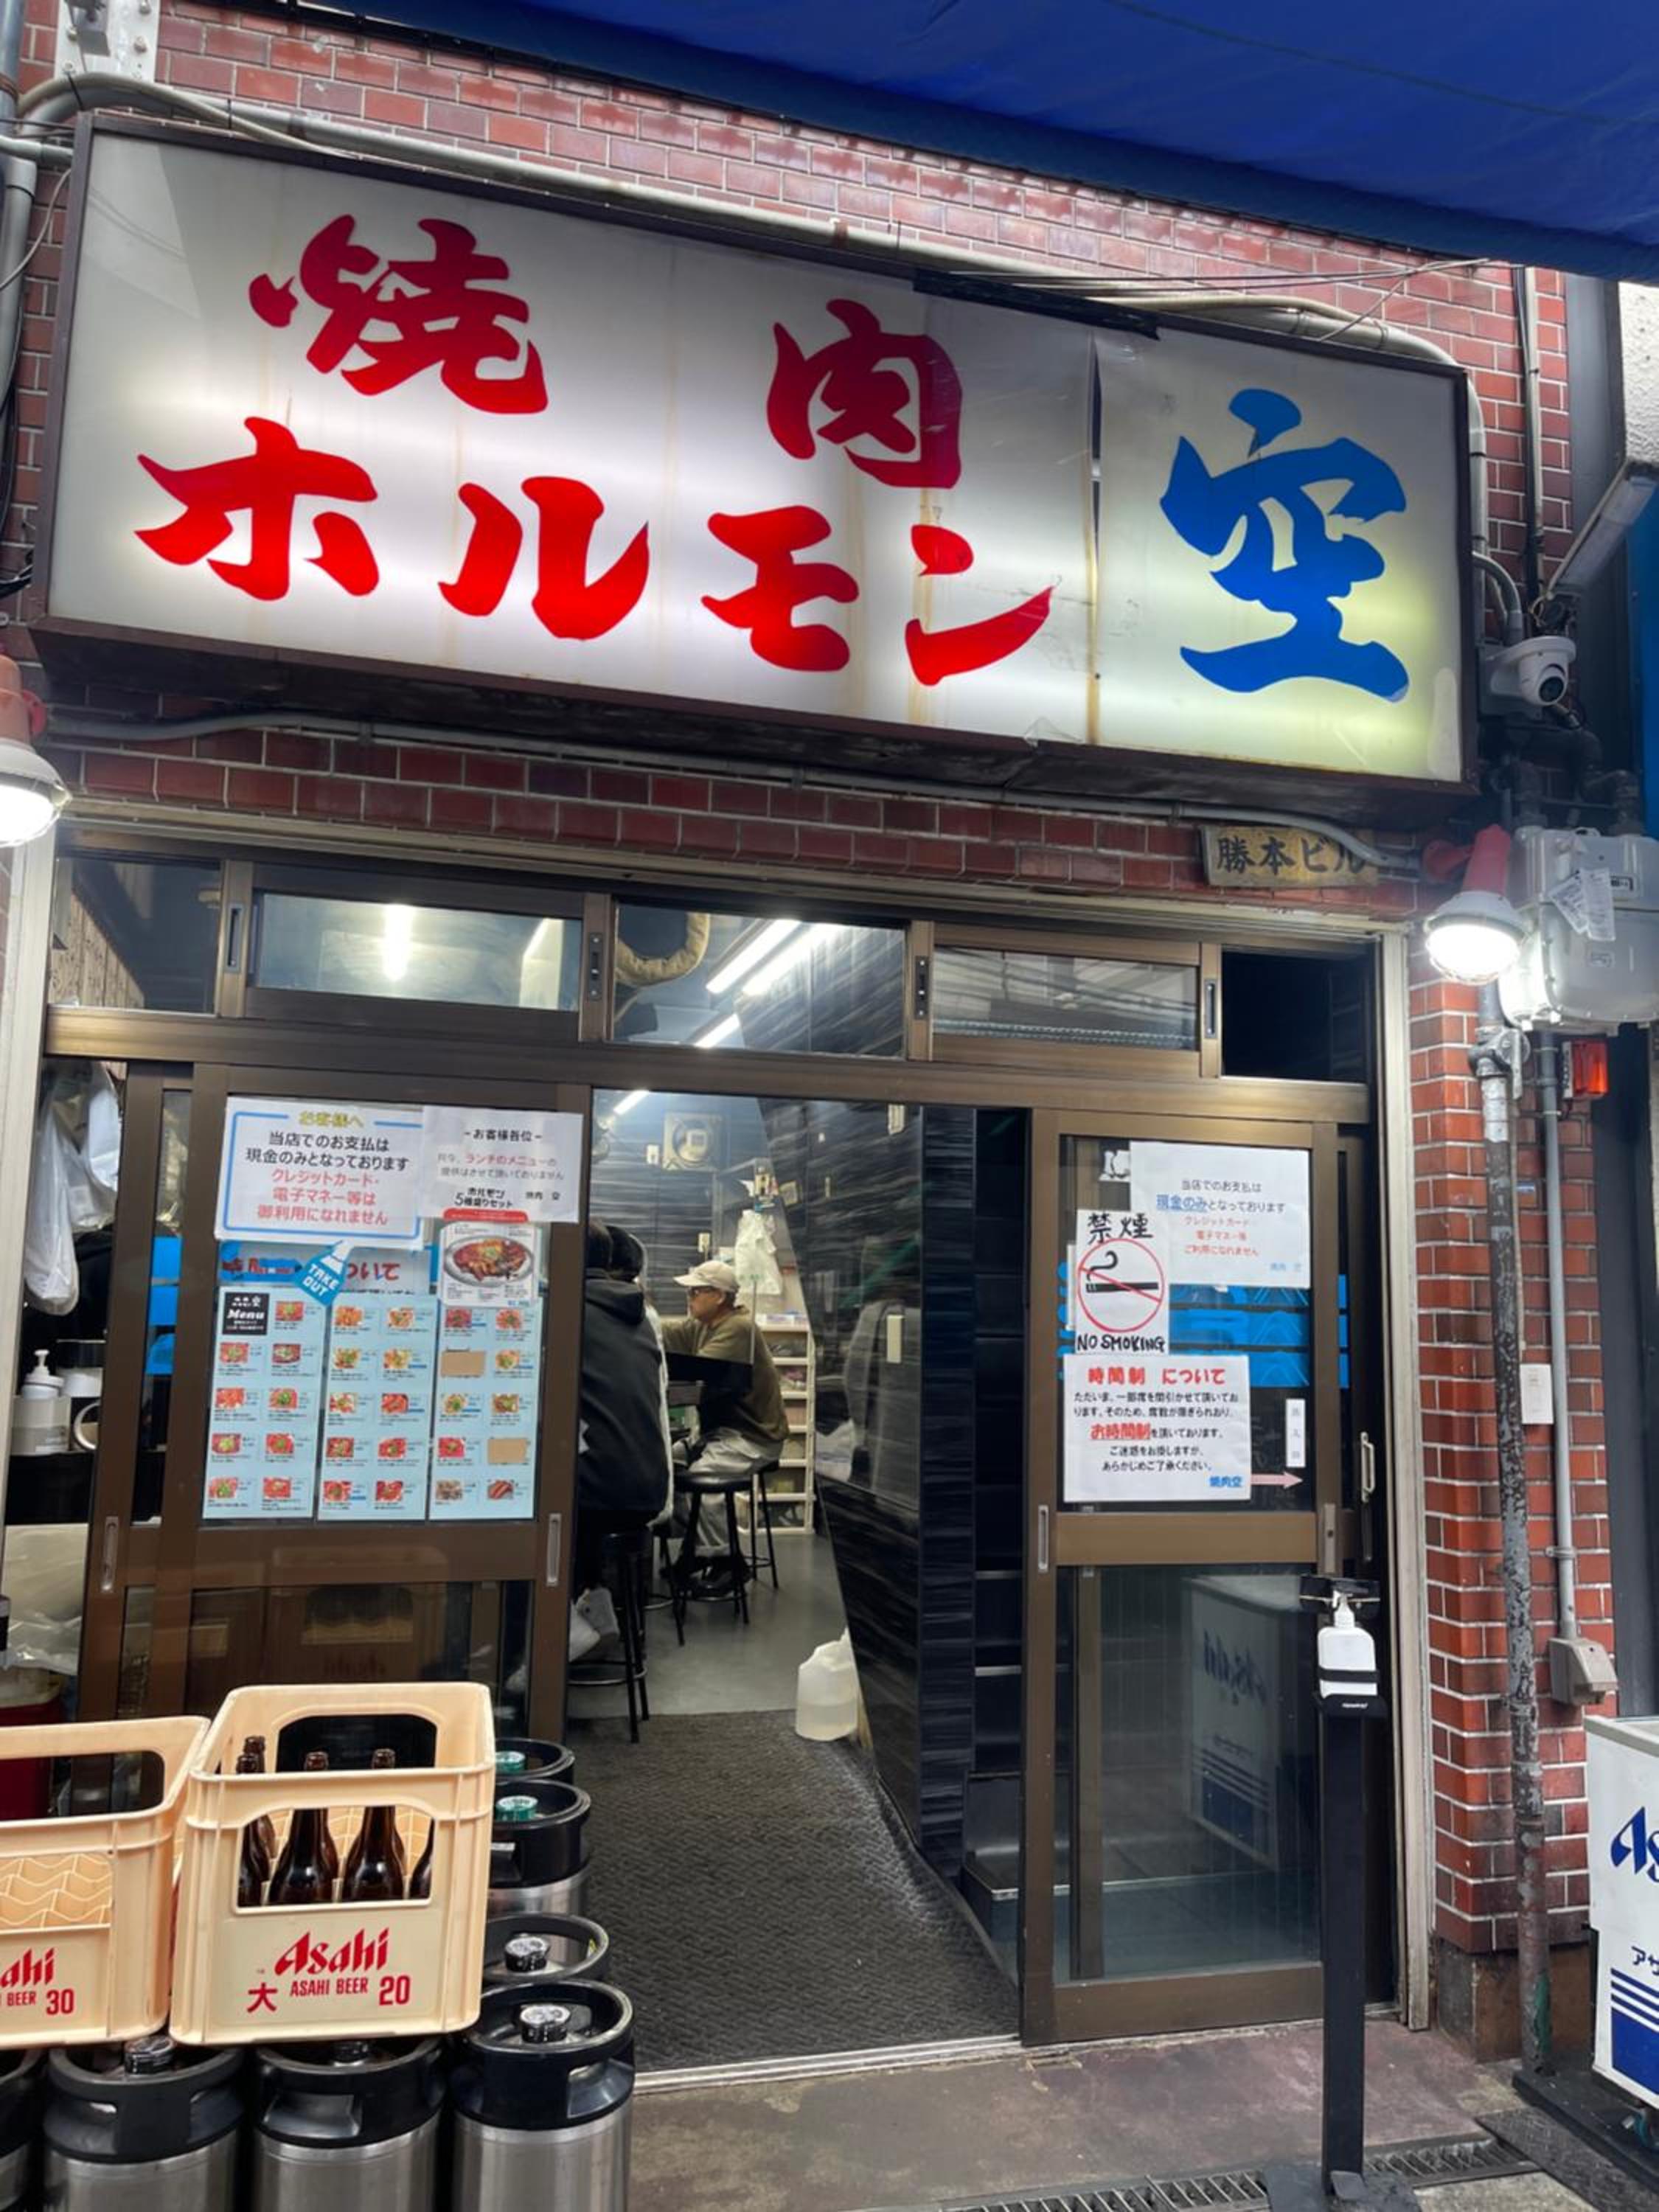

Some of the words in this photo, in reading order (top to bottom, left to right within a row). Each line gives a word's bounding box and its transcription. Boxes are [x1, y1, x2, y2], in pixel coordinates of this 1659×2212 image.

[248, 215, 962, 489] 焼肉
[133, 416, 1054, 686] ホルモン
[1160, 388, 1409, 702] 空
[1217, 835, 1366, 875] 勝本ビル
[268, 1130, 390, 1152] 当店でのお支払は
[246, 1147, 410, 1171] 現金のみとなっております
[273, 1187, 377, 1206] 電子マネー等は
[1181, 1180, 1262, 1193] 当店でのお支払は
[1155, 1194, 1285, 1214] 現金のみとなっております
[1088, 1209, 1154, 1245] 禁煙
[302, 1276, 329, 1296] OUT
[307, 1262, 340, 1290] TAKE
[226, 1308, 265, 1319] Menu
[1077, 1334, 1097, 1352] NO
[1101, 1334, 1166, 1352] SMOKING
[1088, 1366, 1146, 1385] 時間制
[1162, 1368, 1225, 1385] について
[274, 1927, 389, 1976] Asahi
[0, 1947, 55, 1988] ahi
[7, 1991, 36, 2006] BEER
[46, 1988, 74, 2015] 30
[247, 1982, 278, 2013] 大
[290, 1979, 330, 1997] ASAHI
[335, 1977, 369, 1994] BEER
[379, 1975, 411, 2006] 20
